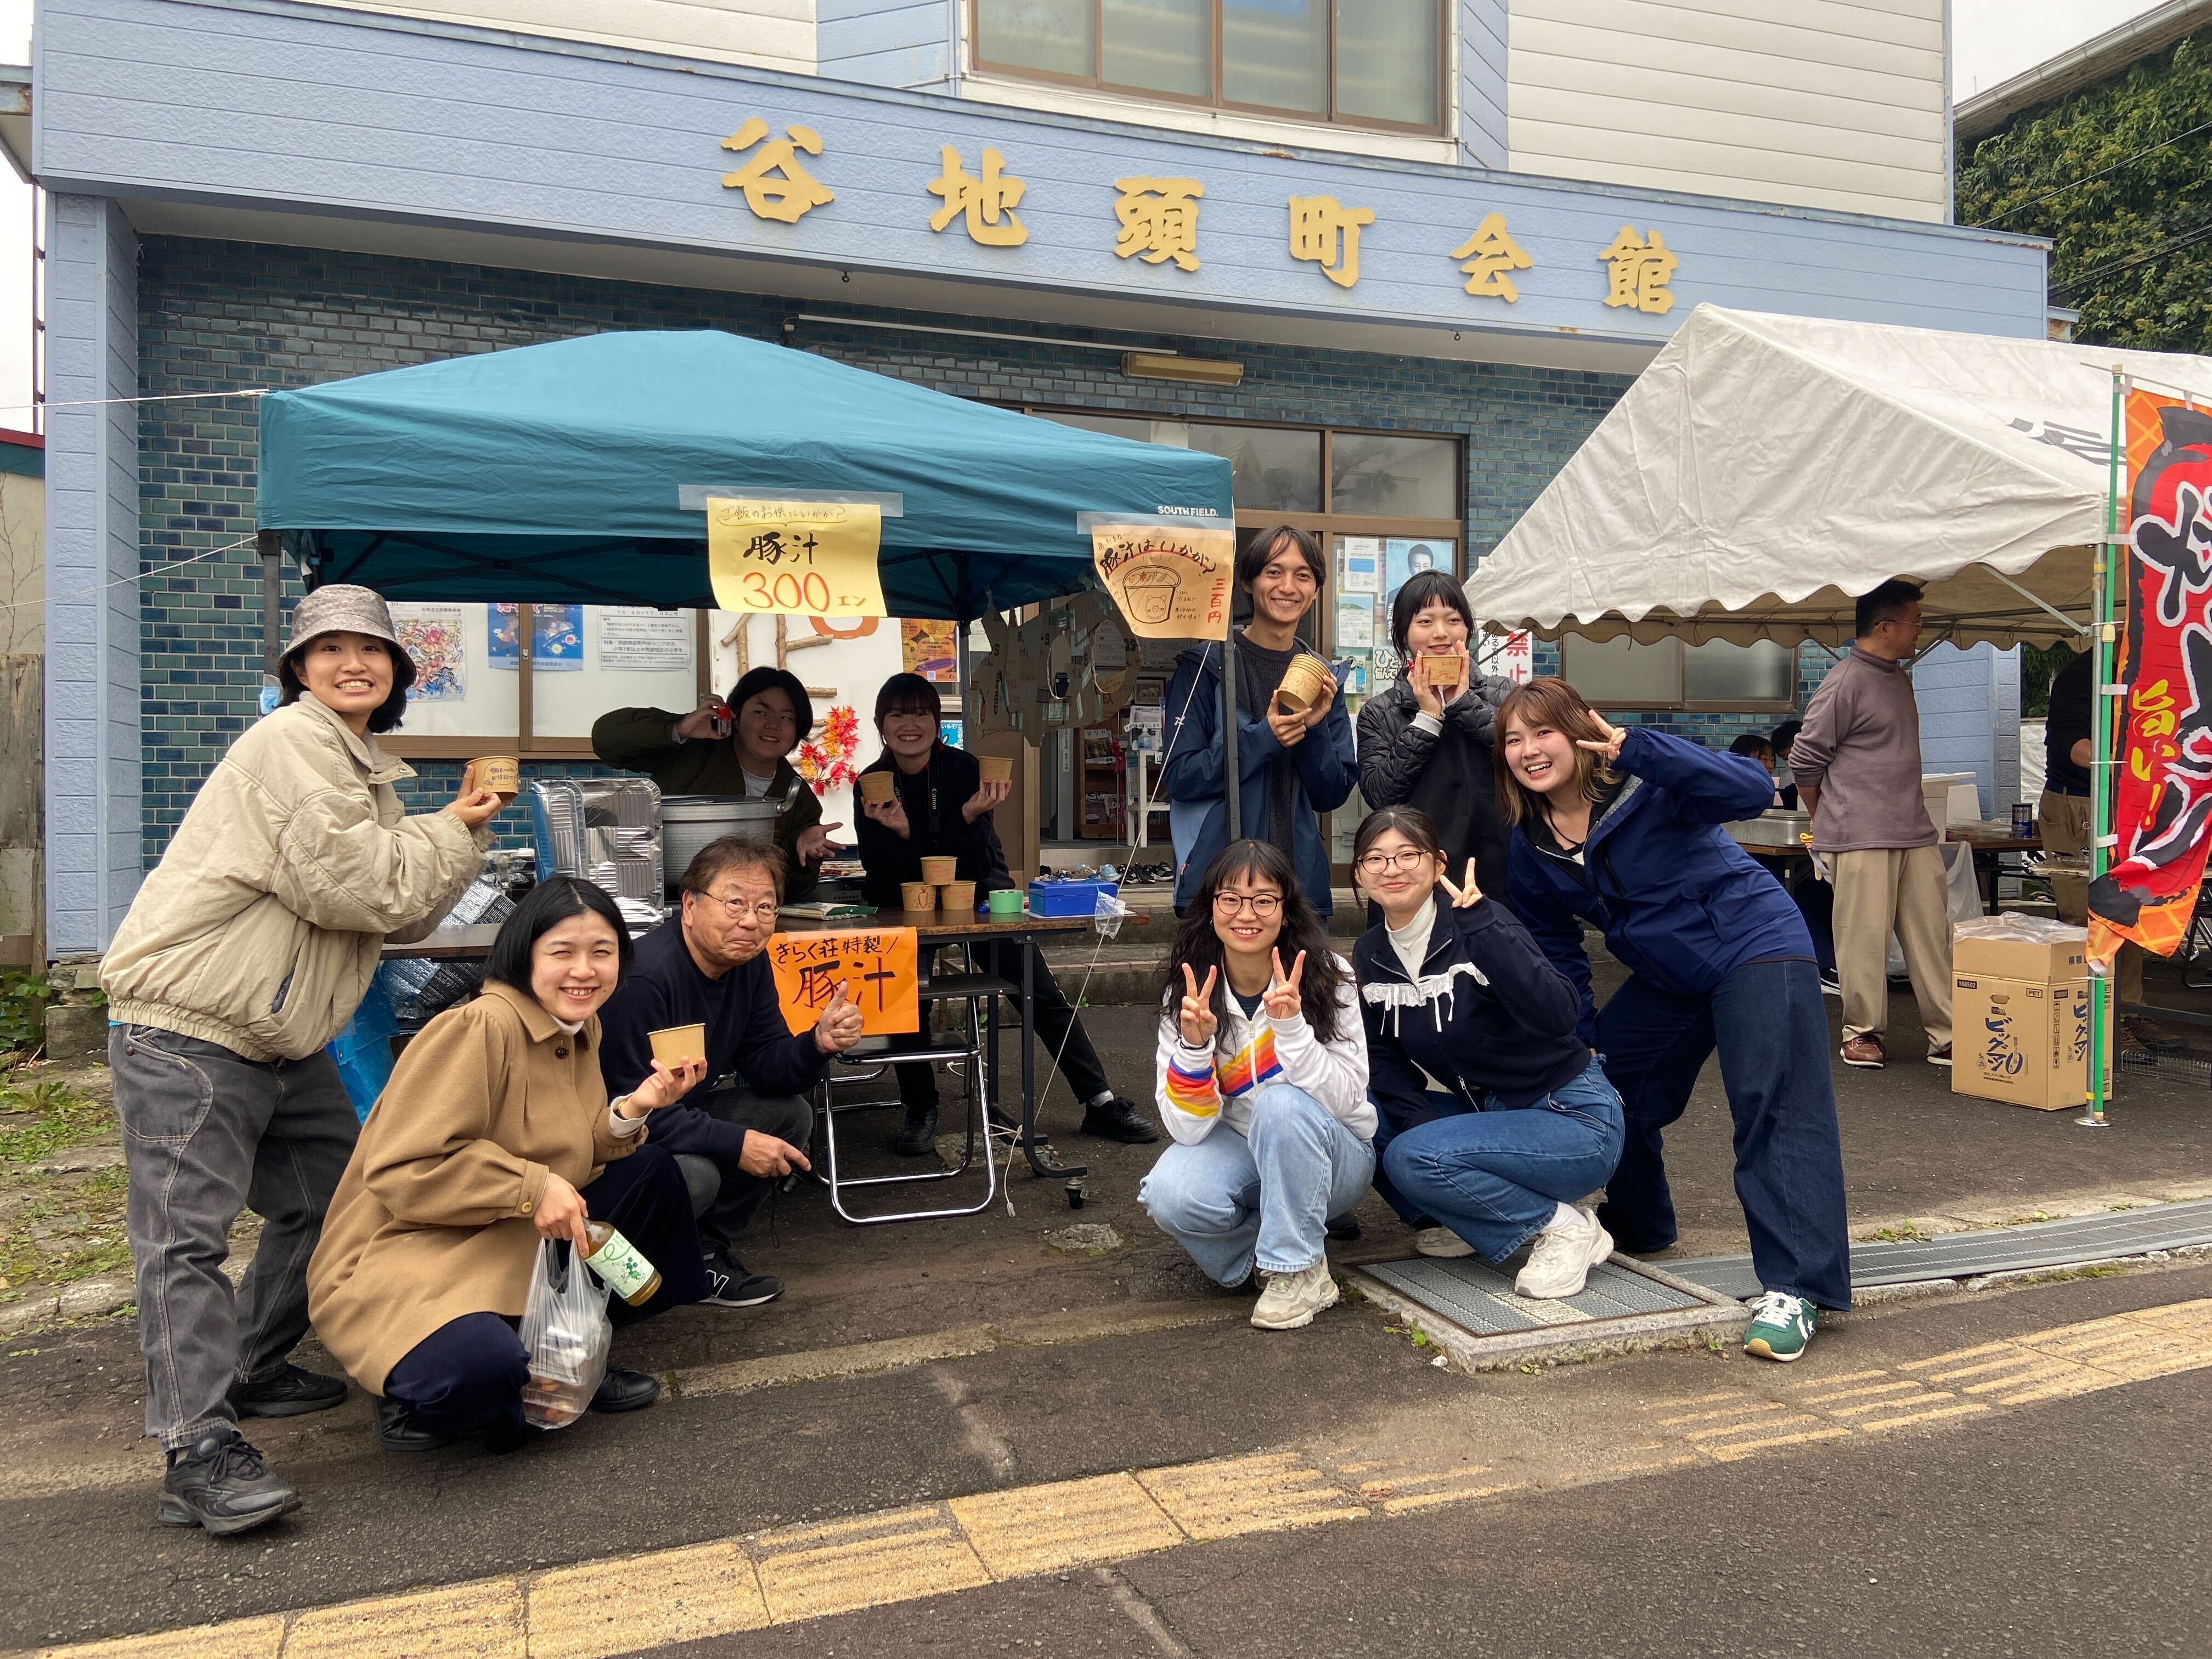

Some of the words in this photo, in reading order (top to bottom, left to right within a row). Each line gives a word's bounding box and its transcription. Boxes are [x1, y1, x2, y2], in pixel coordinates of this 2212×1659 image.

[720, 117, 1679, 315] 谷地頭町会館
[743, 532, 819, 565] 豚汁
[743, 572, 830, 612] 300
[1375, 650, 1402, 668] ひと
[1506, 632, 1528, 685] 禁止
[792, 957, 896, 1013] 豚汁
[1985, 1017, 2012, 1071] ビッグマン
